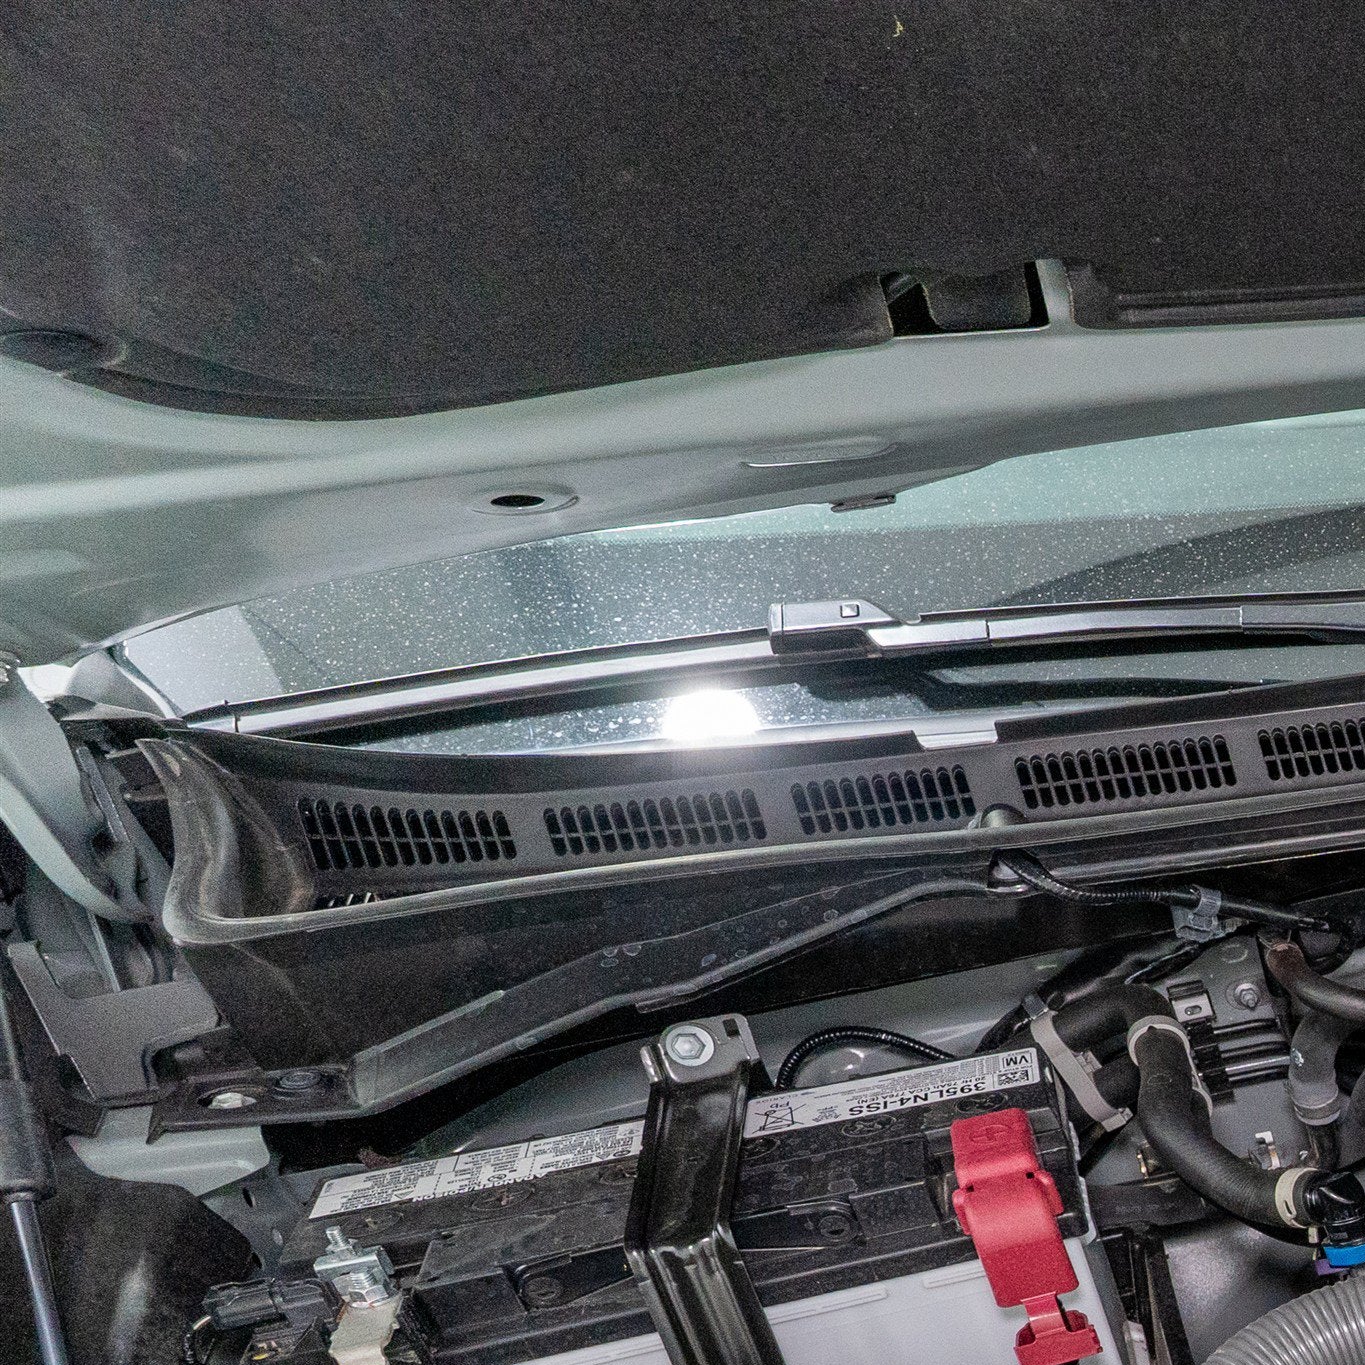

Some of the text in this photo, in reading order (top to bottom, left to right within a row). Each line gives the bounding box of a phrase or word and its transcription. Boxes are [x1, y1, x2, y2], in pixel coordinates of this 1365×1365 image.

[1005, 1054, 1028, 1067] VM
[769, 1100, 790, 1110] Pb
[849, 1083, 986, 1116] 395LN4-ISS
